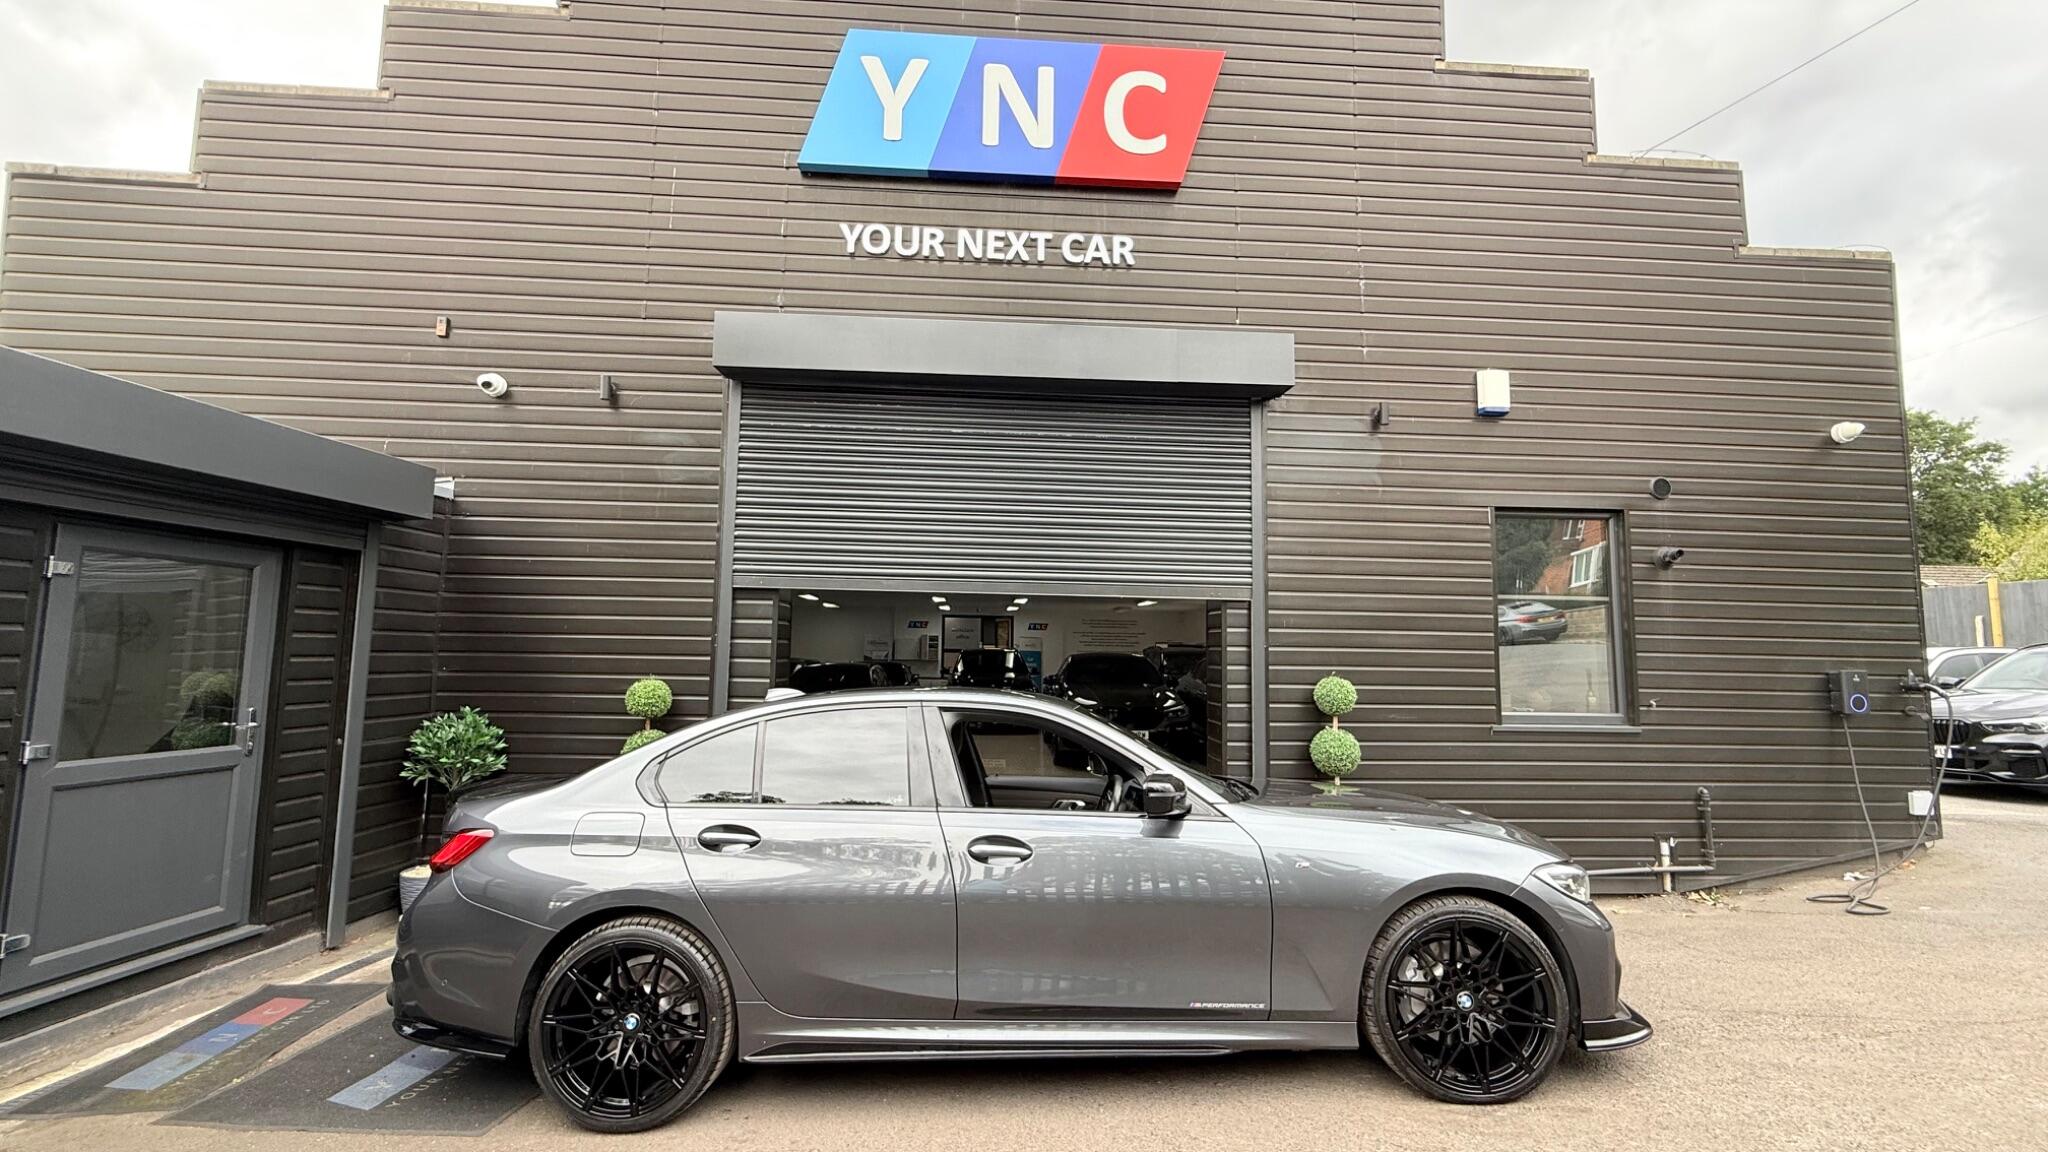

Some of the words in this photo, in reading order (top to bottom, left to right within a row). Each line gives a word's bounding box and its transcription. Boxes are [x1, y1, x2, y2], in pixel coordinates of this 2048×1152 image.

[860, 55, 1168, 155] YNC
[838, 222, 946, 258] YOUR
[956, 228, 1053, 263] NEXT
[1061, 232, 1136, 266] CAR
[385, 1077, 444, 1108] YOUR
